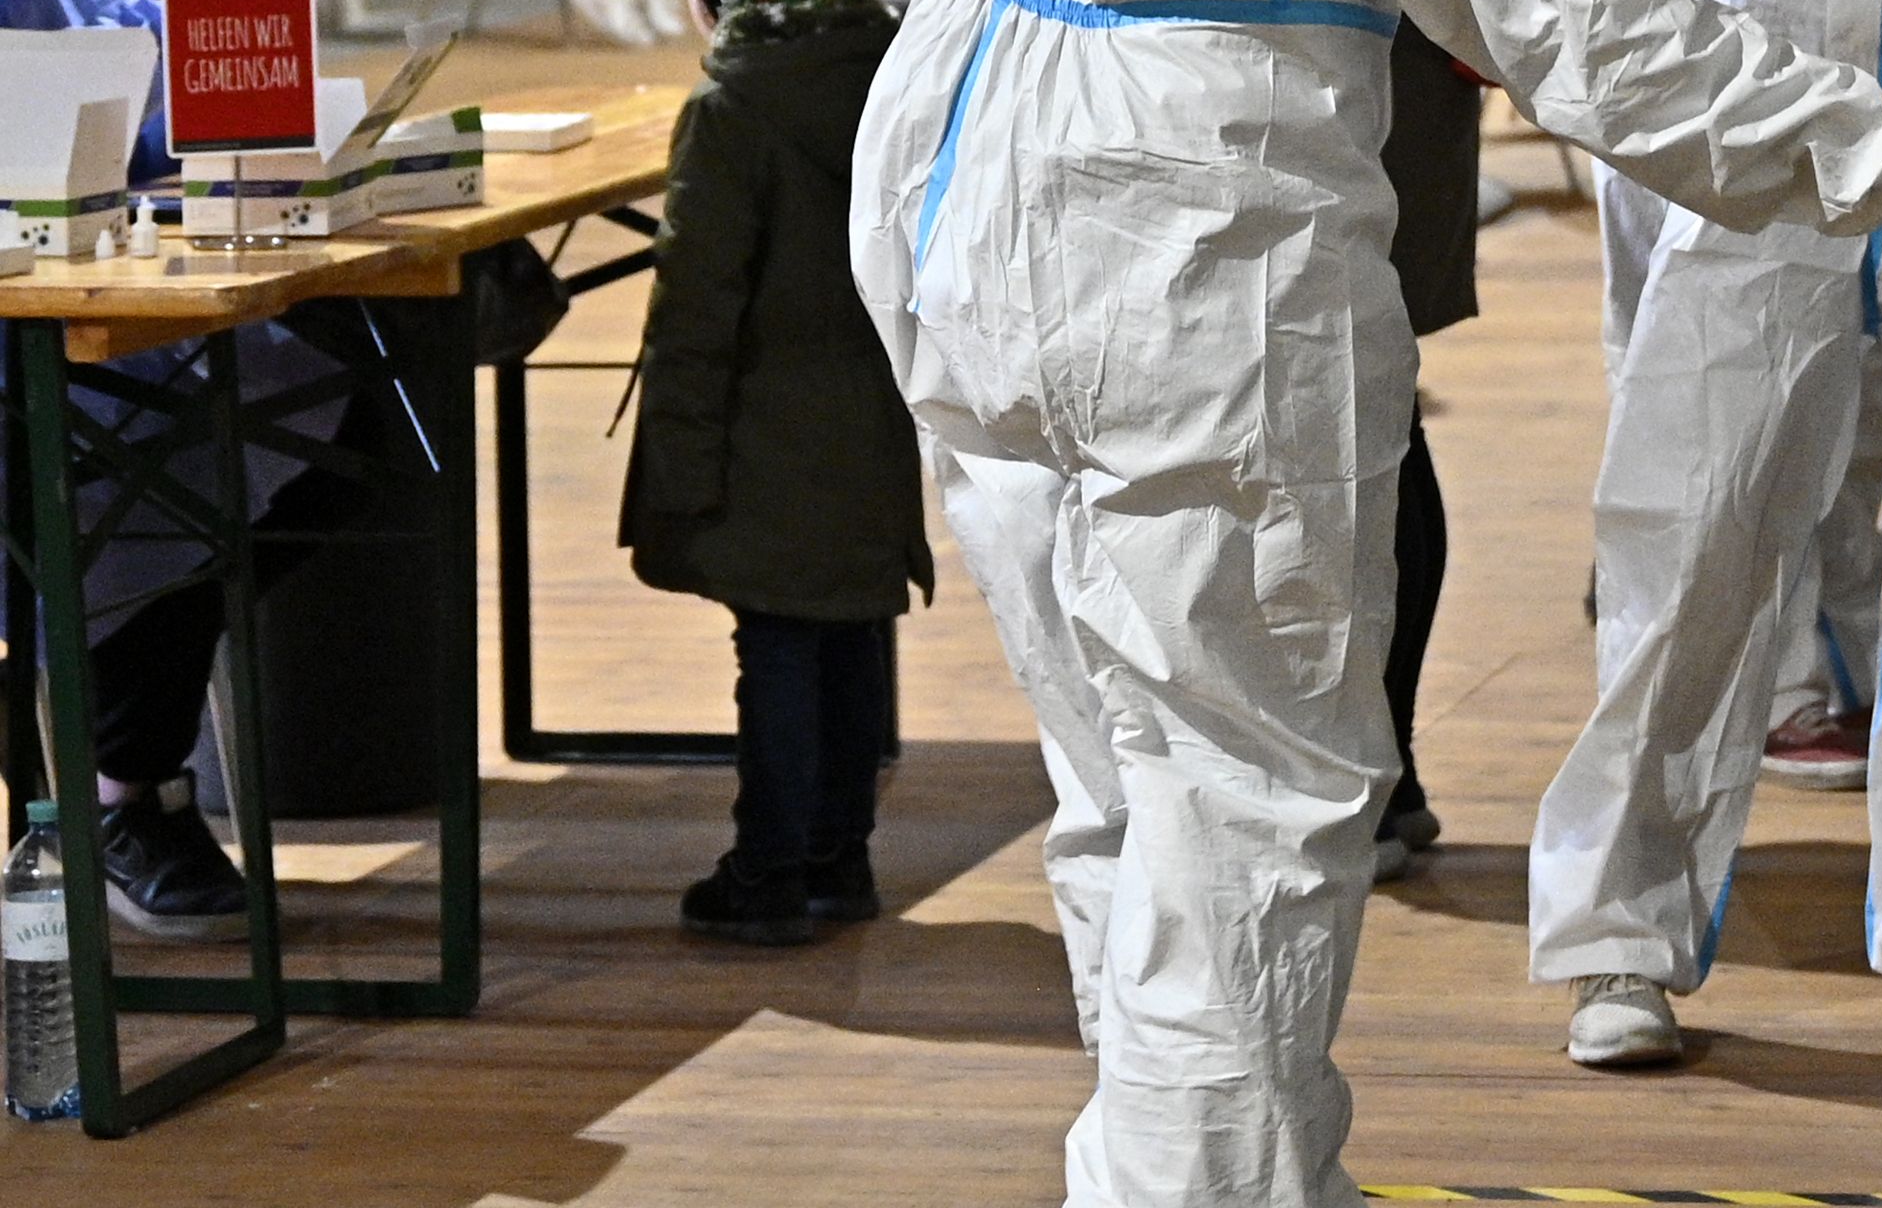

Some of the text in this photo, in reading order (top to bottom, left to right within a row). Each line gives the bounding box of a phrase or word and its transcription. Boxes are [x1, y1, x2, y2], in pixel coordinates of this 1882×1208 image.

[187, 13, 293, 52] HELFEN WIR
[183, 54, 301, 94] GEMEINSAM
